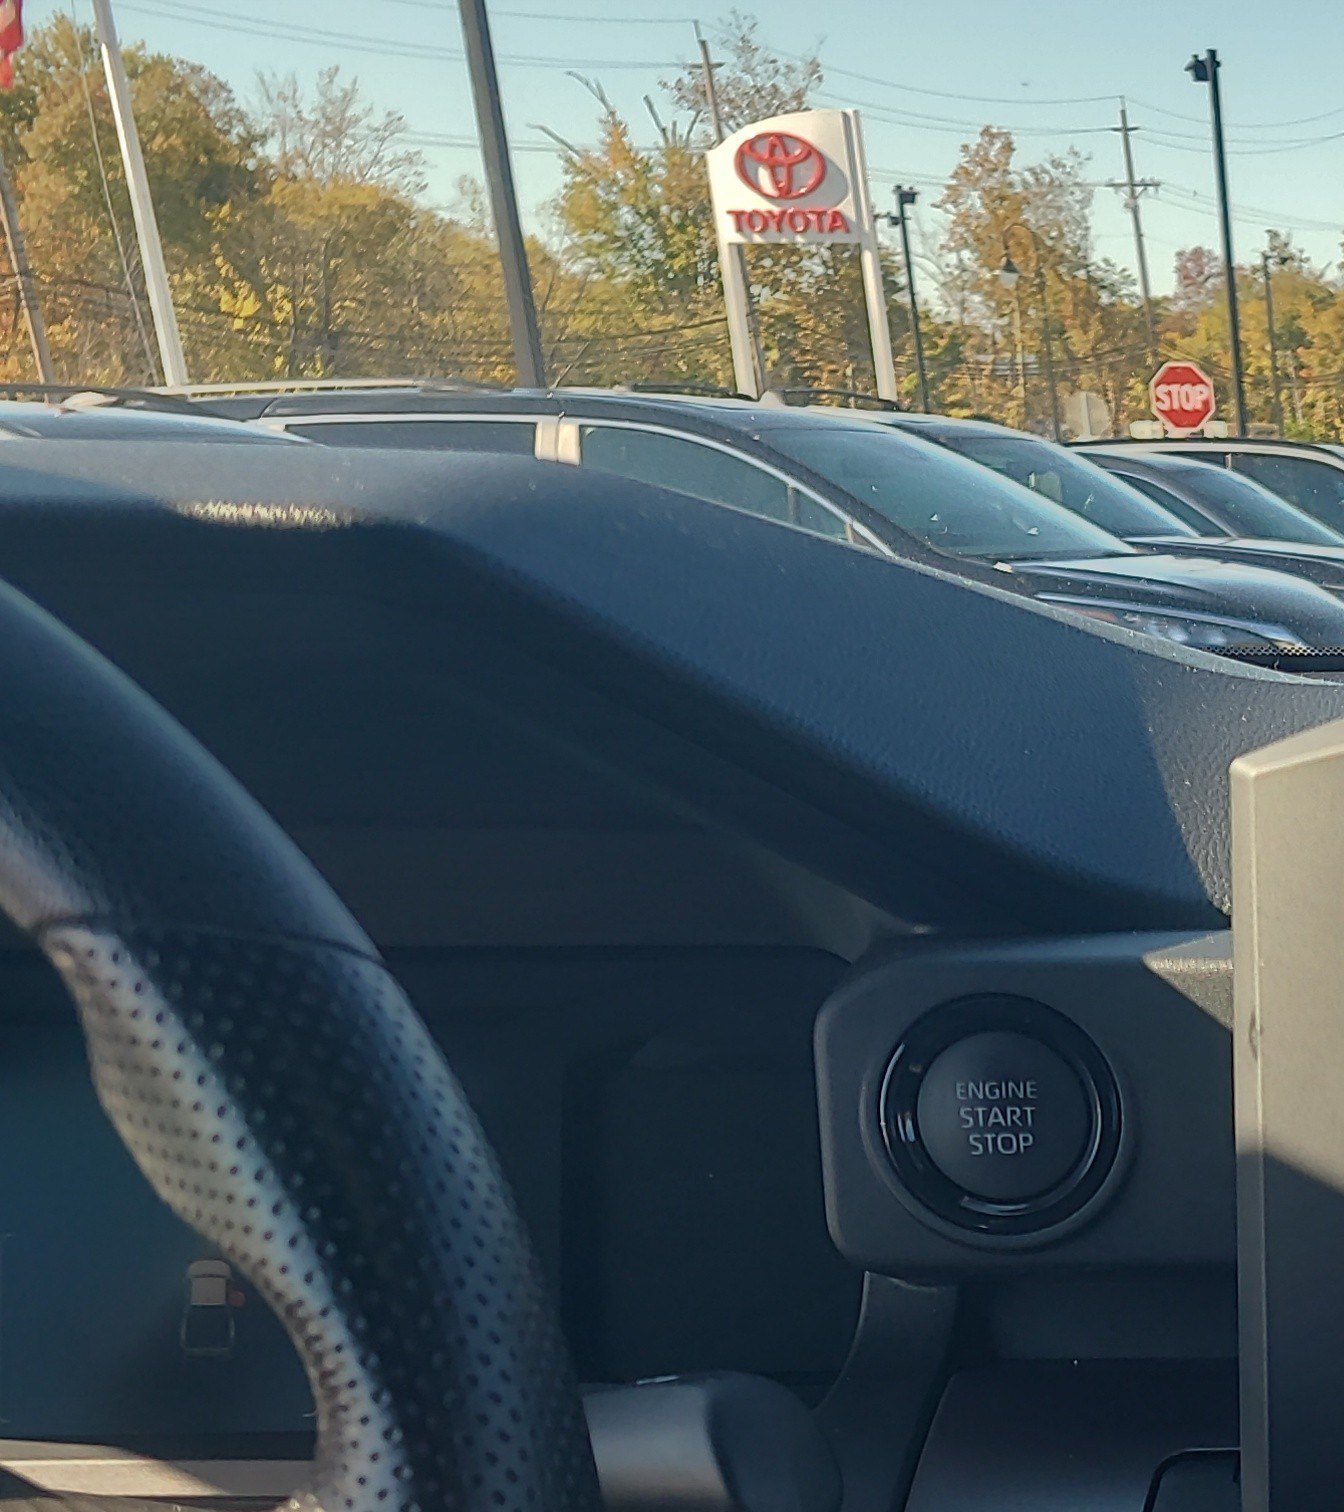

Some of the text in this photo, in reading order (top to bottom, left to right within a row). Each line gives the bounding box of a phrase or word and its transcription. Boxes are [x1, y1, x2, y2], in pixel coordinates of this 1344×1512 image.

[726, 208, 850, 234] TOYOTA
[1155, 383, 1209, 411] STOP
[956, 1081, 1038, 1100] ENGINE
[959, 1106, 1036, 1128] START
[968, 1133, 1034, 1156] STOP
